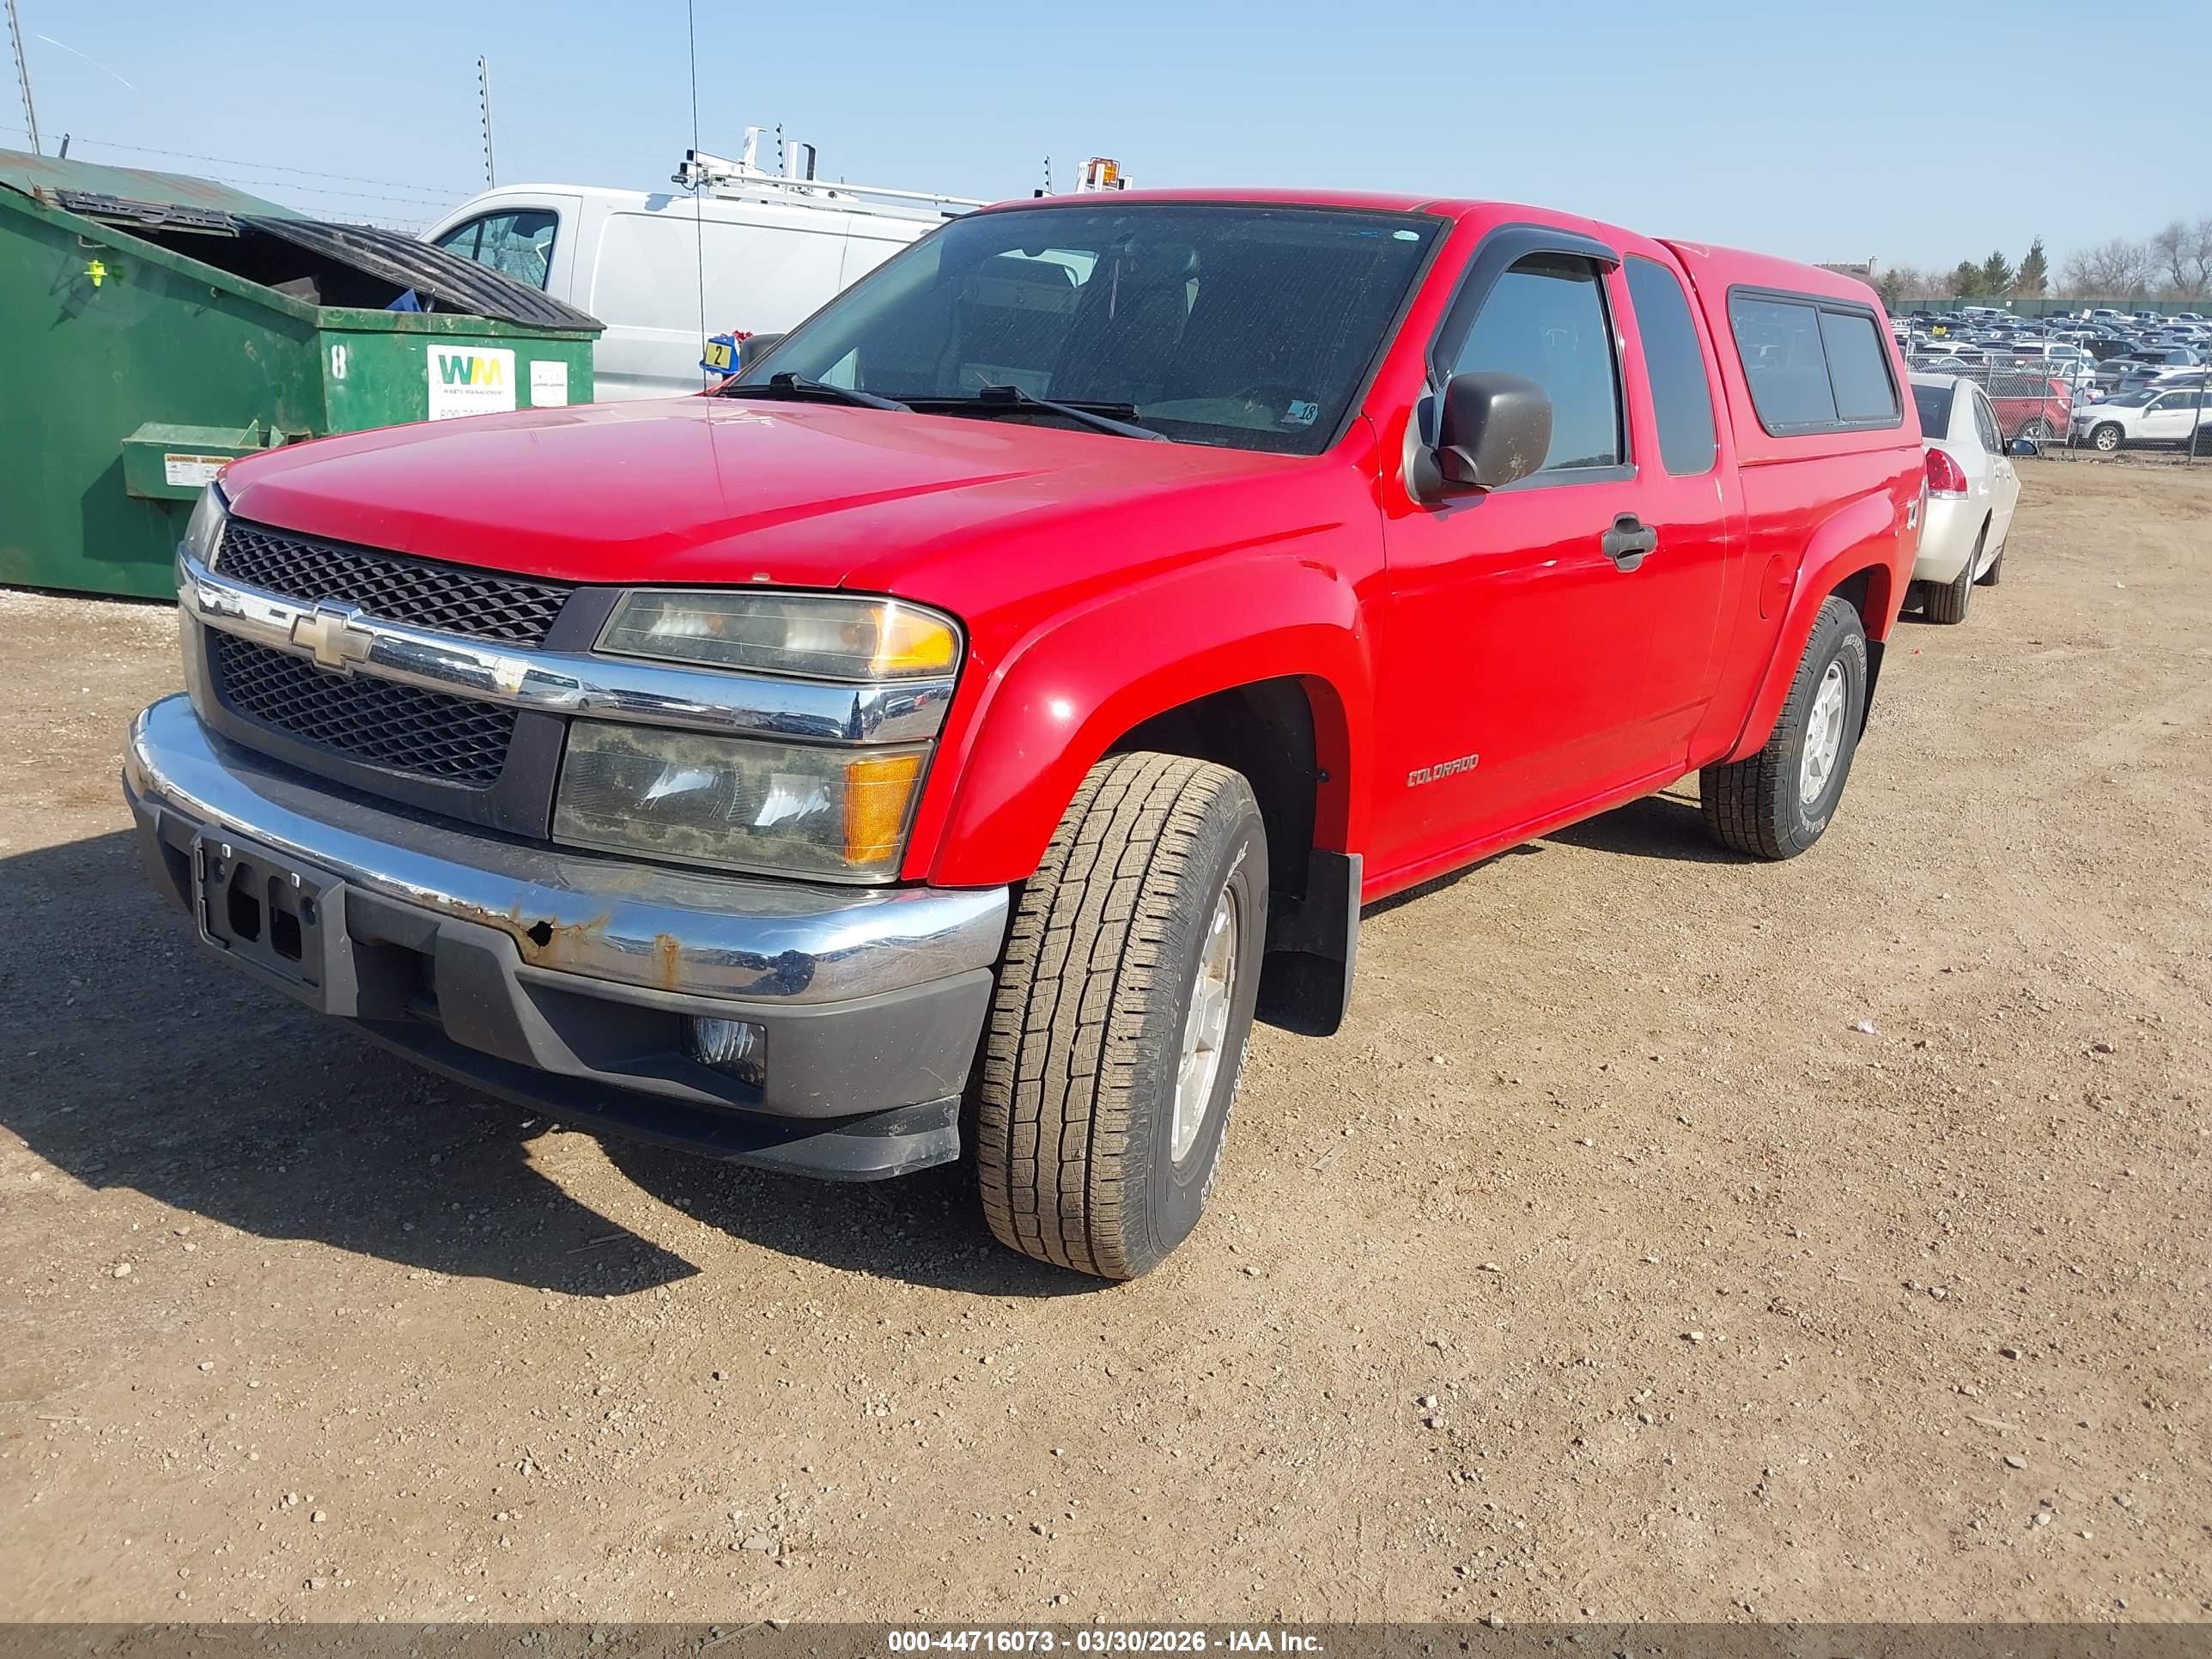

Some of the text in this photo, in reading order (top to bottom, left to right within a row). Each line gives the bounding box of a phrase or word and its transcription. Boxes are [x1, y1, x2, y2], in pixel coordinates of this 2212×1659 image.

[714, 345, 722, 366] 2
[438, 355, 503, 386] WM
[1299, 404, 1316, 421] 18
[1407, 753, 1480, 787] COLORADO
